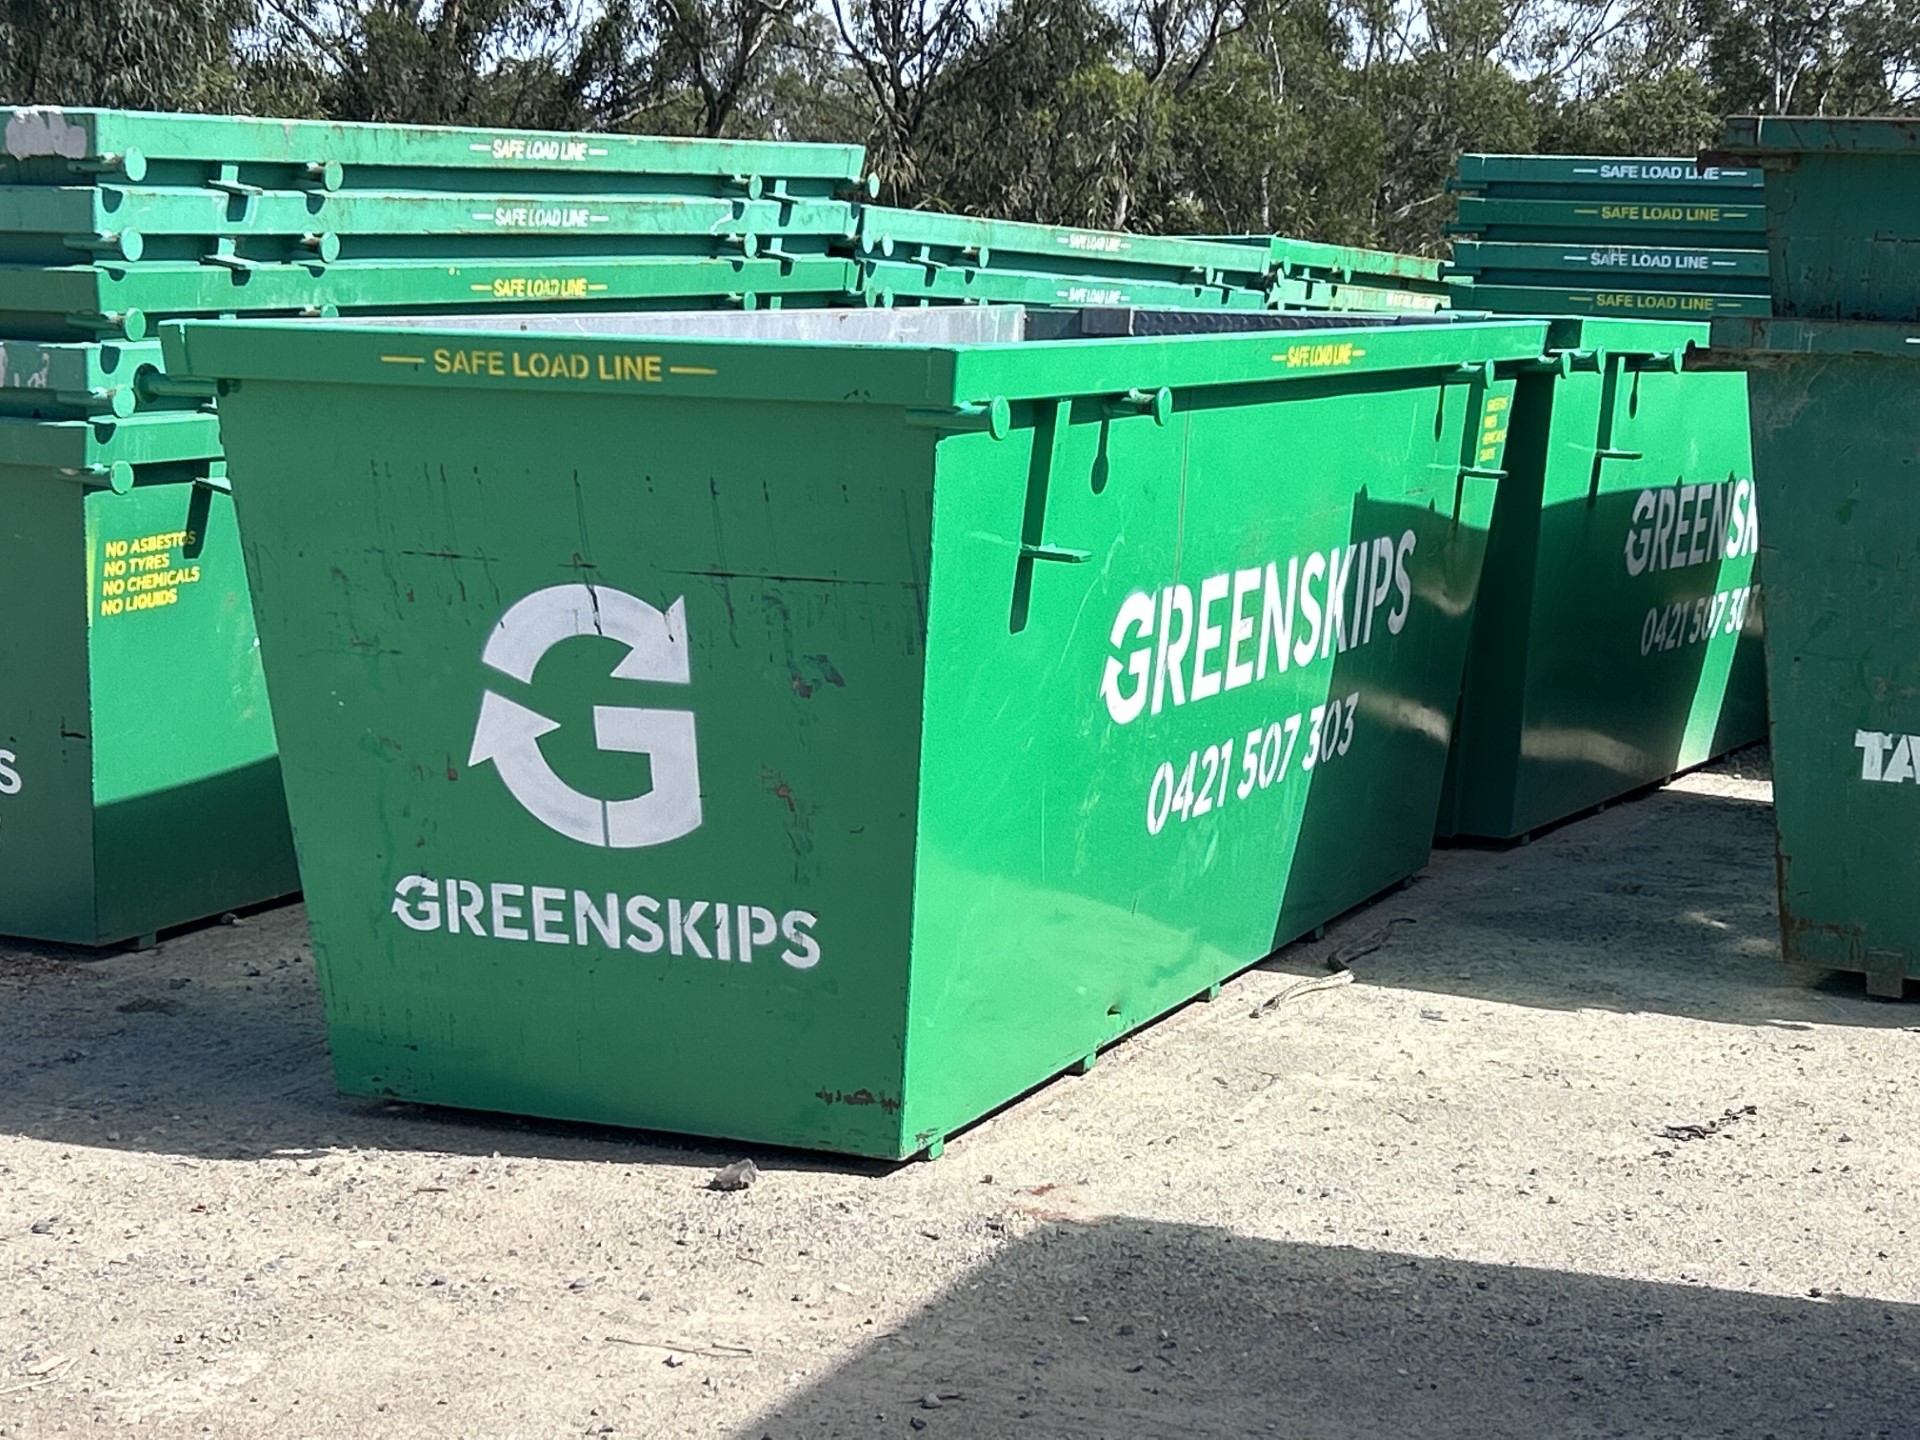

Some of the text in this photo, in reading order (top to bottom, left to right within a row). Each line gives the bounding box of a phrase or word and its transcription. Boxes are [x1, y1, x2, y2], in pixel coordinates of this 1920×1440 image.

[492, 139, 588, 161] SAFE LOAD LINE
[1600, 165, 1639, 180] SAFE
[1641, 166, 1682, 180] LOAD
[495, 207, 590, 228] SAFE LOAD LINE
[1601, 206, 1720, 222] SAFE LOAD LINE
[1590, 252, 1709, 270] SAFE LOAD LINE
[493, 277, 588, 298] SAFE LOAD LINE
[1596, 293, 1714, 311] SAFE LOAD LINE
[434, 348, 662, 382] SAFE LOAD LINE
[1287, 342, 1353, 368] SAFE LOAD LINE
[105, 531, 197, 558] NO ASBESTOS
[103, 553, 170, 577] NO TYRES
[102, 566, 200, 597] NO CHEMICALS
[101, 588, 178, 616] NO LIQUIDS
[1099, 529, 1417, 725] GREENSKIPS
[1641, 600, 1690, 657] 0421
[1688, 591, 1729, 644] 507
[1146, 692, 1360, 836] 0421 507 303
[1854, 728, 1920, 785] TA
[391, 874, 822, 969] GREENSKIPS
